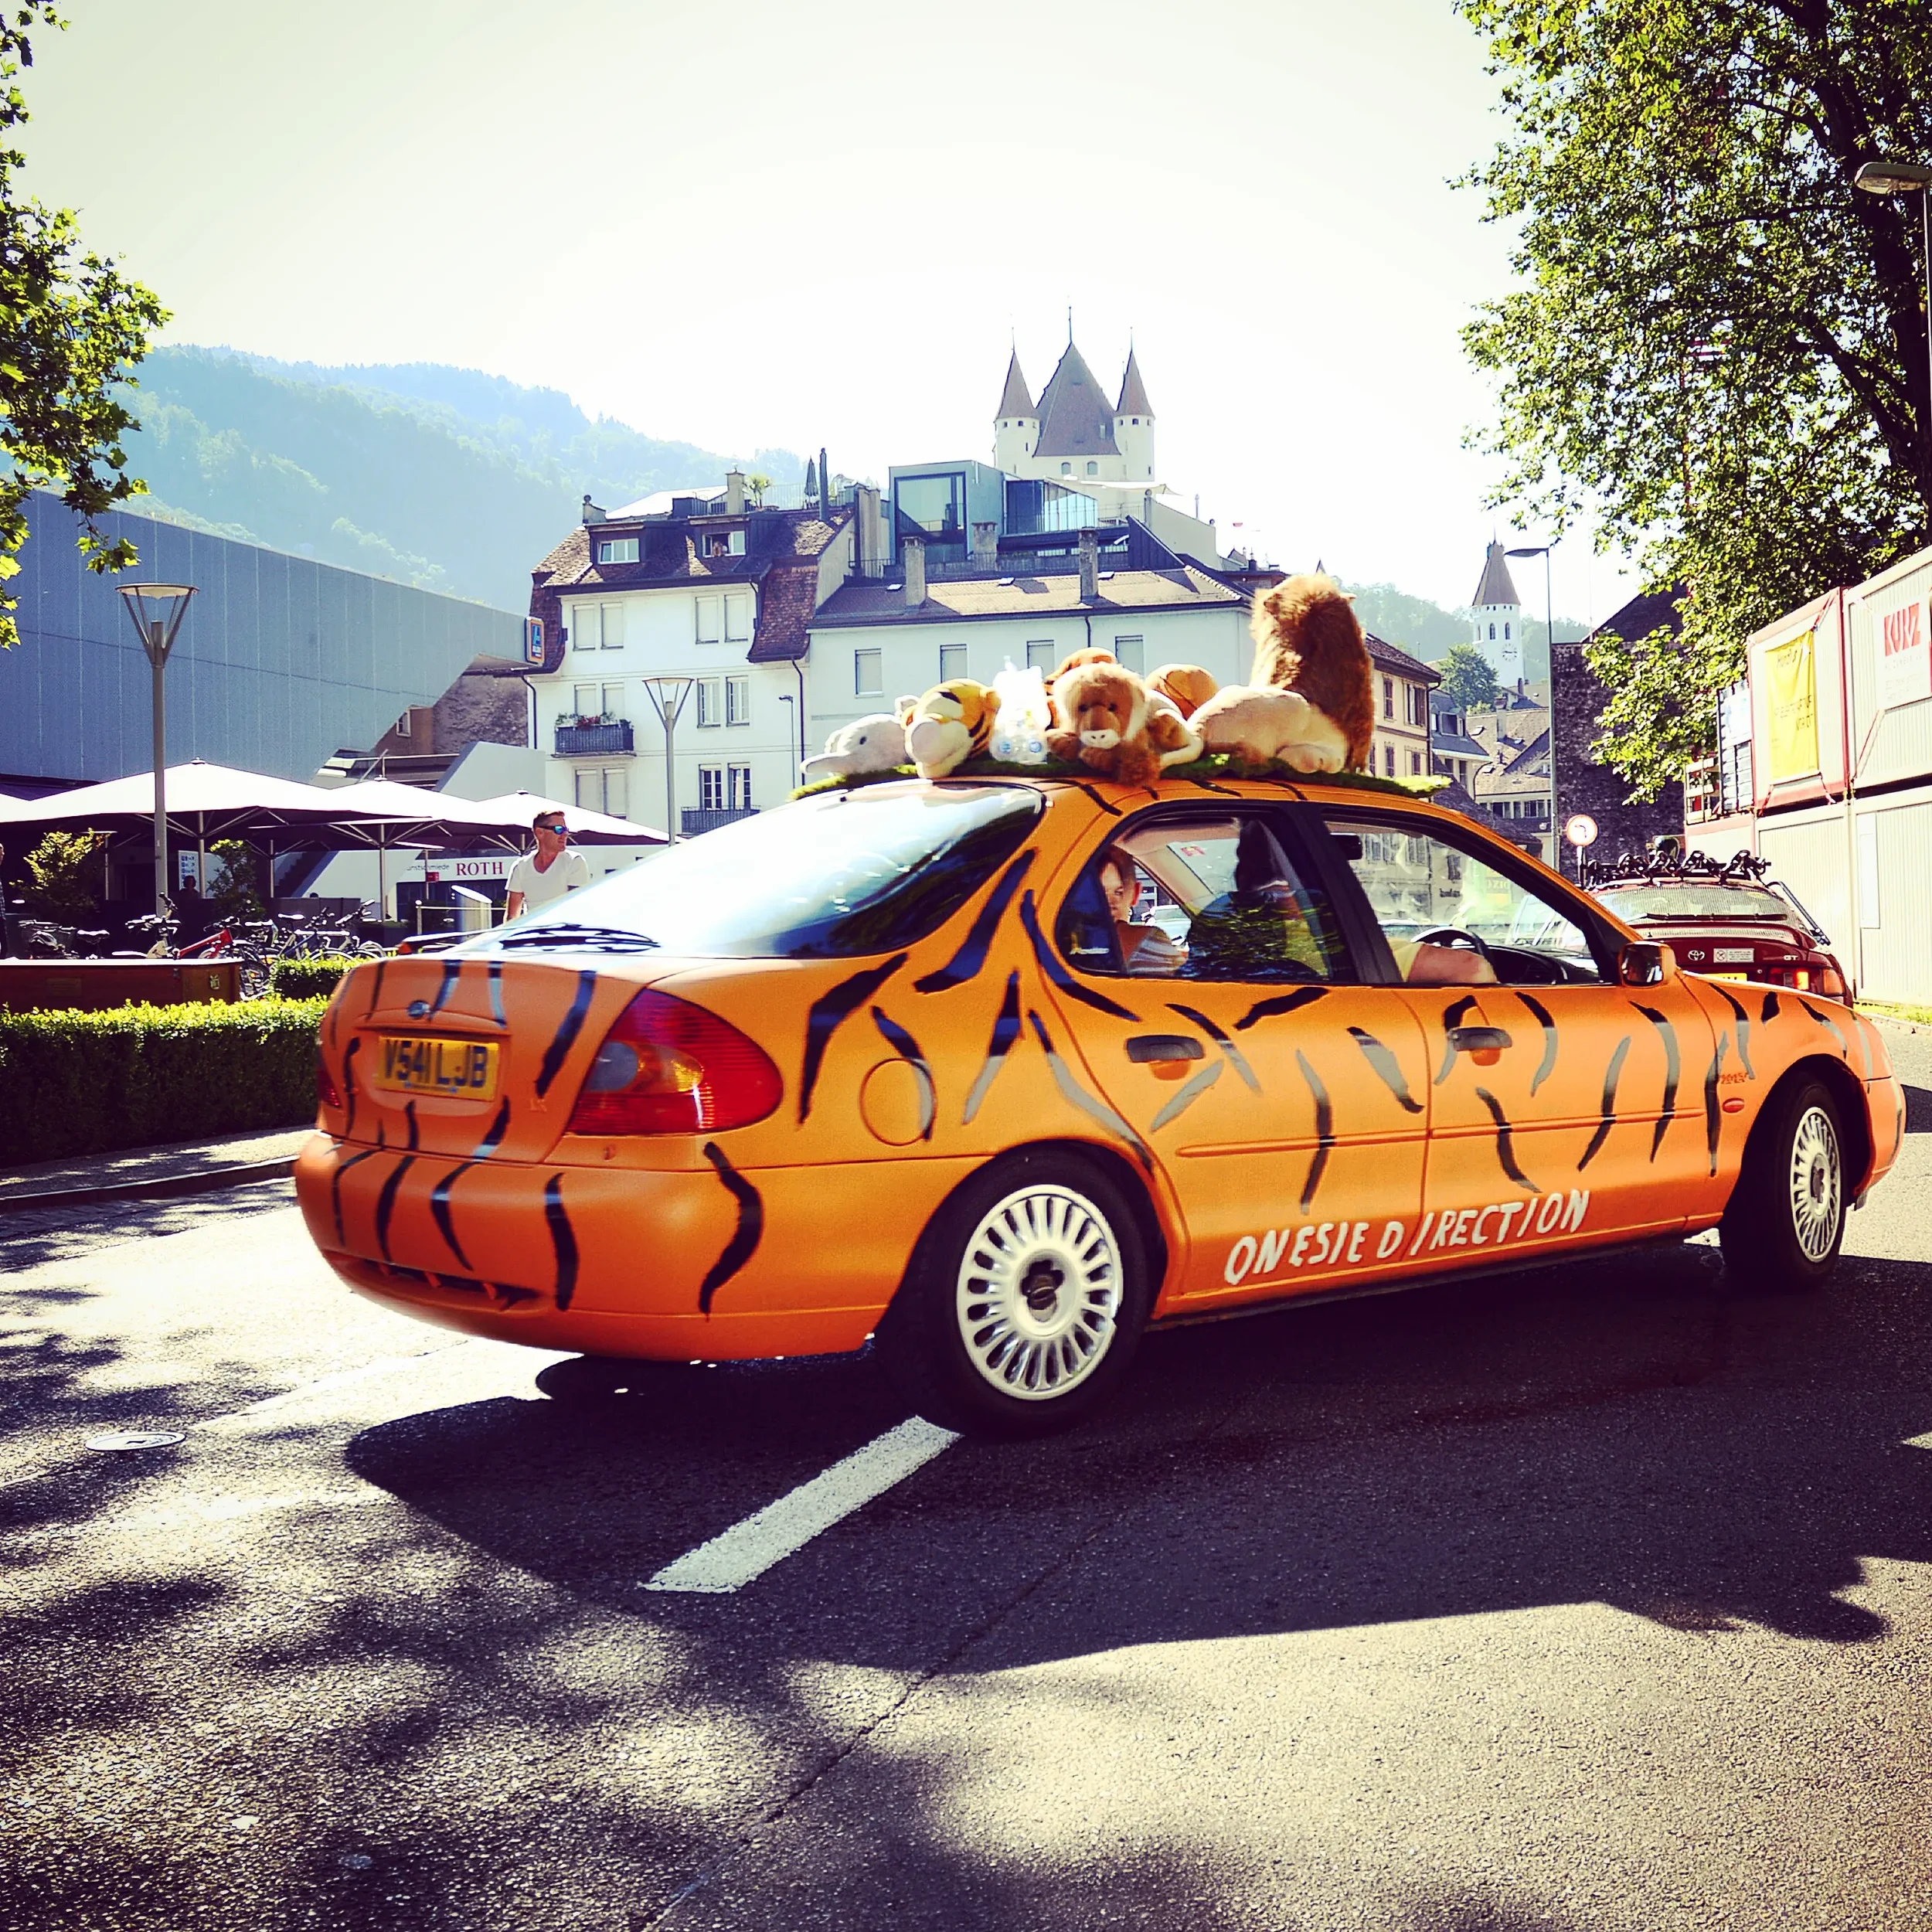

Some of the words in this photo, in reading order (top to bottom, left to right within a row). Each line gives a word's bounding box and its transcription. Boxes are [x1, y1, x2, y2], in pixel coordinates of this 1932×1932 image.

[1884, 603, 1920, 657] KURZ
[456, 862, 504, 876] ROTH
[1224, 1222, 1369, 1285] ONESIE
